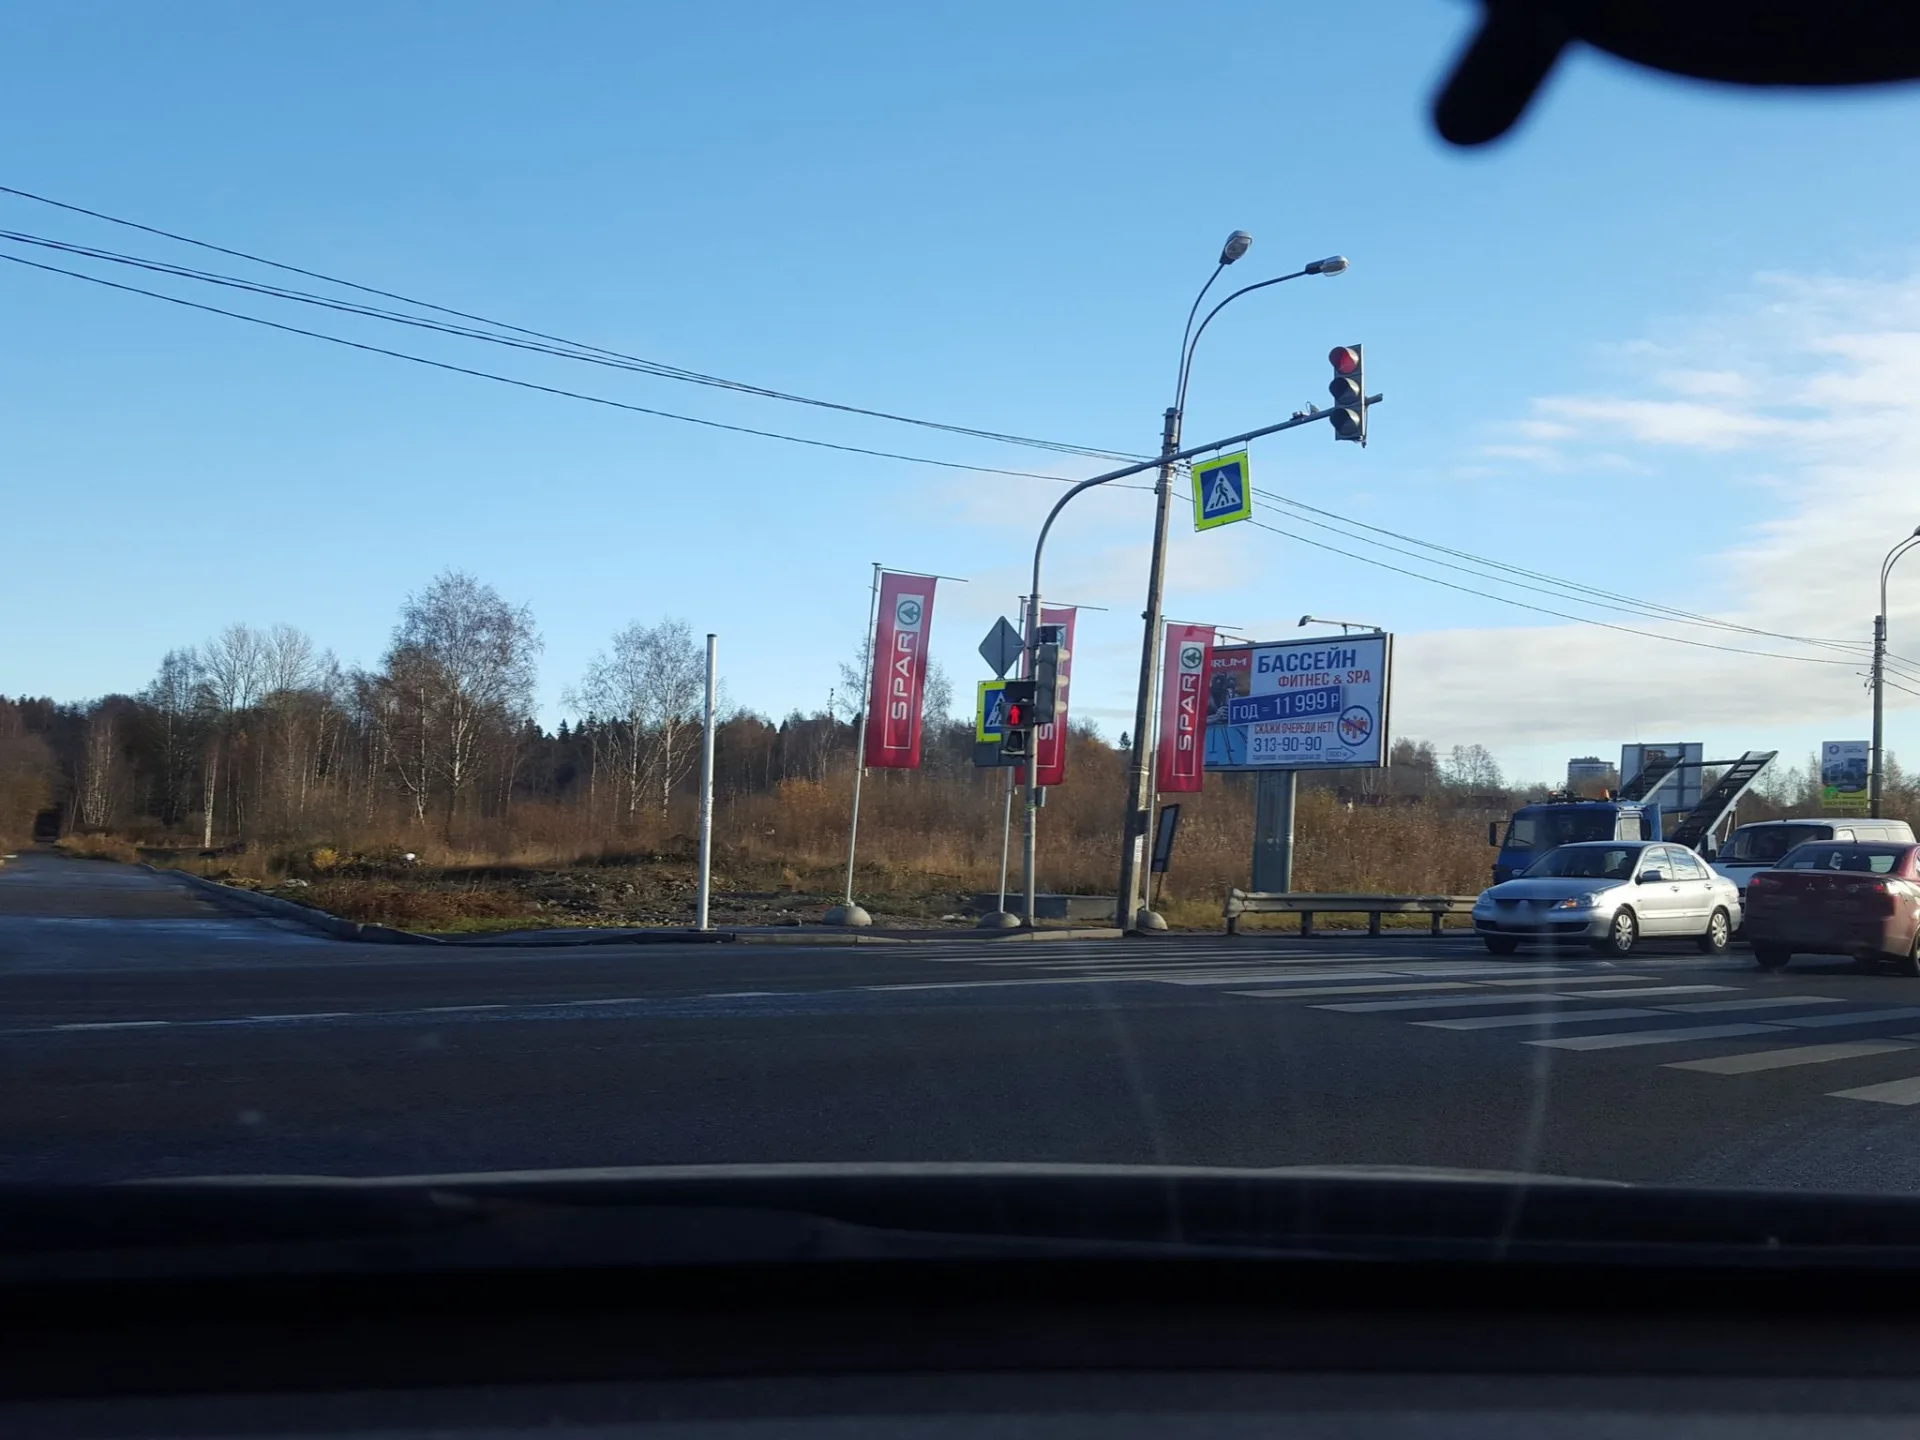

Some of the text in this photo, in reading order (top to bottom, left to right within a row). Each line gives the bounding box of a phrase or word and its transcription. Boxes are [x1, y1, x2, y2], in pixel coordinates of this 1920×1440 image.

[1257, 646, 1357, 674] БАССЕЙН
[891, 632, 914, 721] SPAR
[1278, 669, 1371, 688] ФИТНЕС & SPA
[1178, 675, 1196, 751] SPAR
[1232, 703, 1260, 720] ГОД
[1253, 735, 1322, 752] 313-90-90
